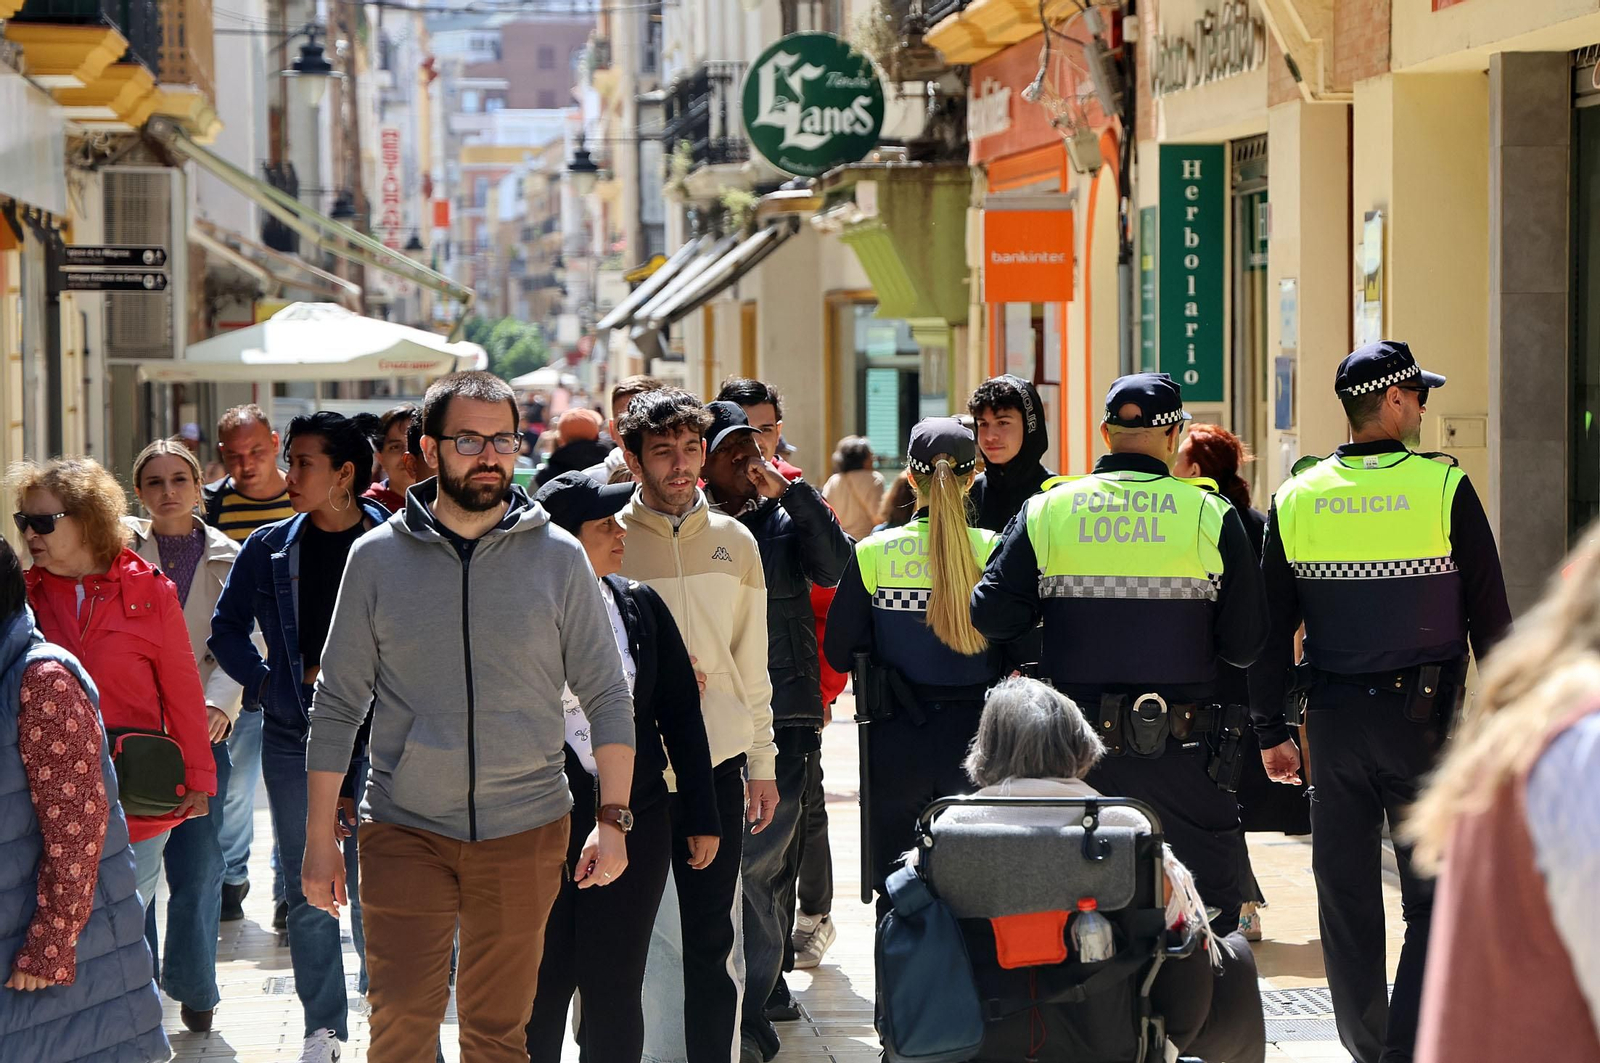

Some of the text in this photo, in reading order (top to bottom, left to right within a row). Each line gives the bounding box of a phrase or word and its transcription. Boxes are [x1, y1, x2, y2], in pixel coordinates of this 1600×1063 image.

[991, 250, 1066, 264] bankinter
[1181, 159, 1202, 386] Herbolario
[1071, 489, 1178, 514] POLICIA
[1314, 495, 1410, 514] POLICIA
[1079, 516, 1166, 543] LOCAL
